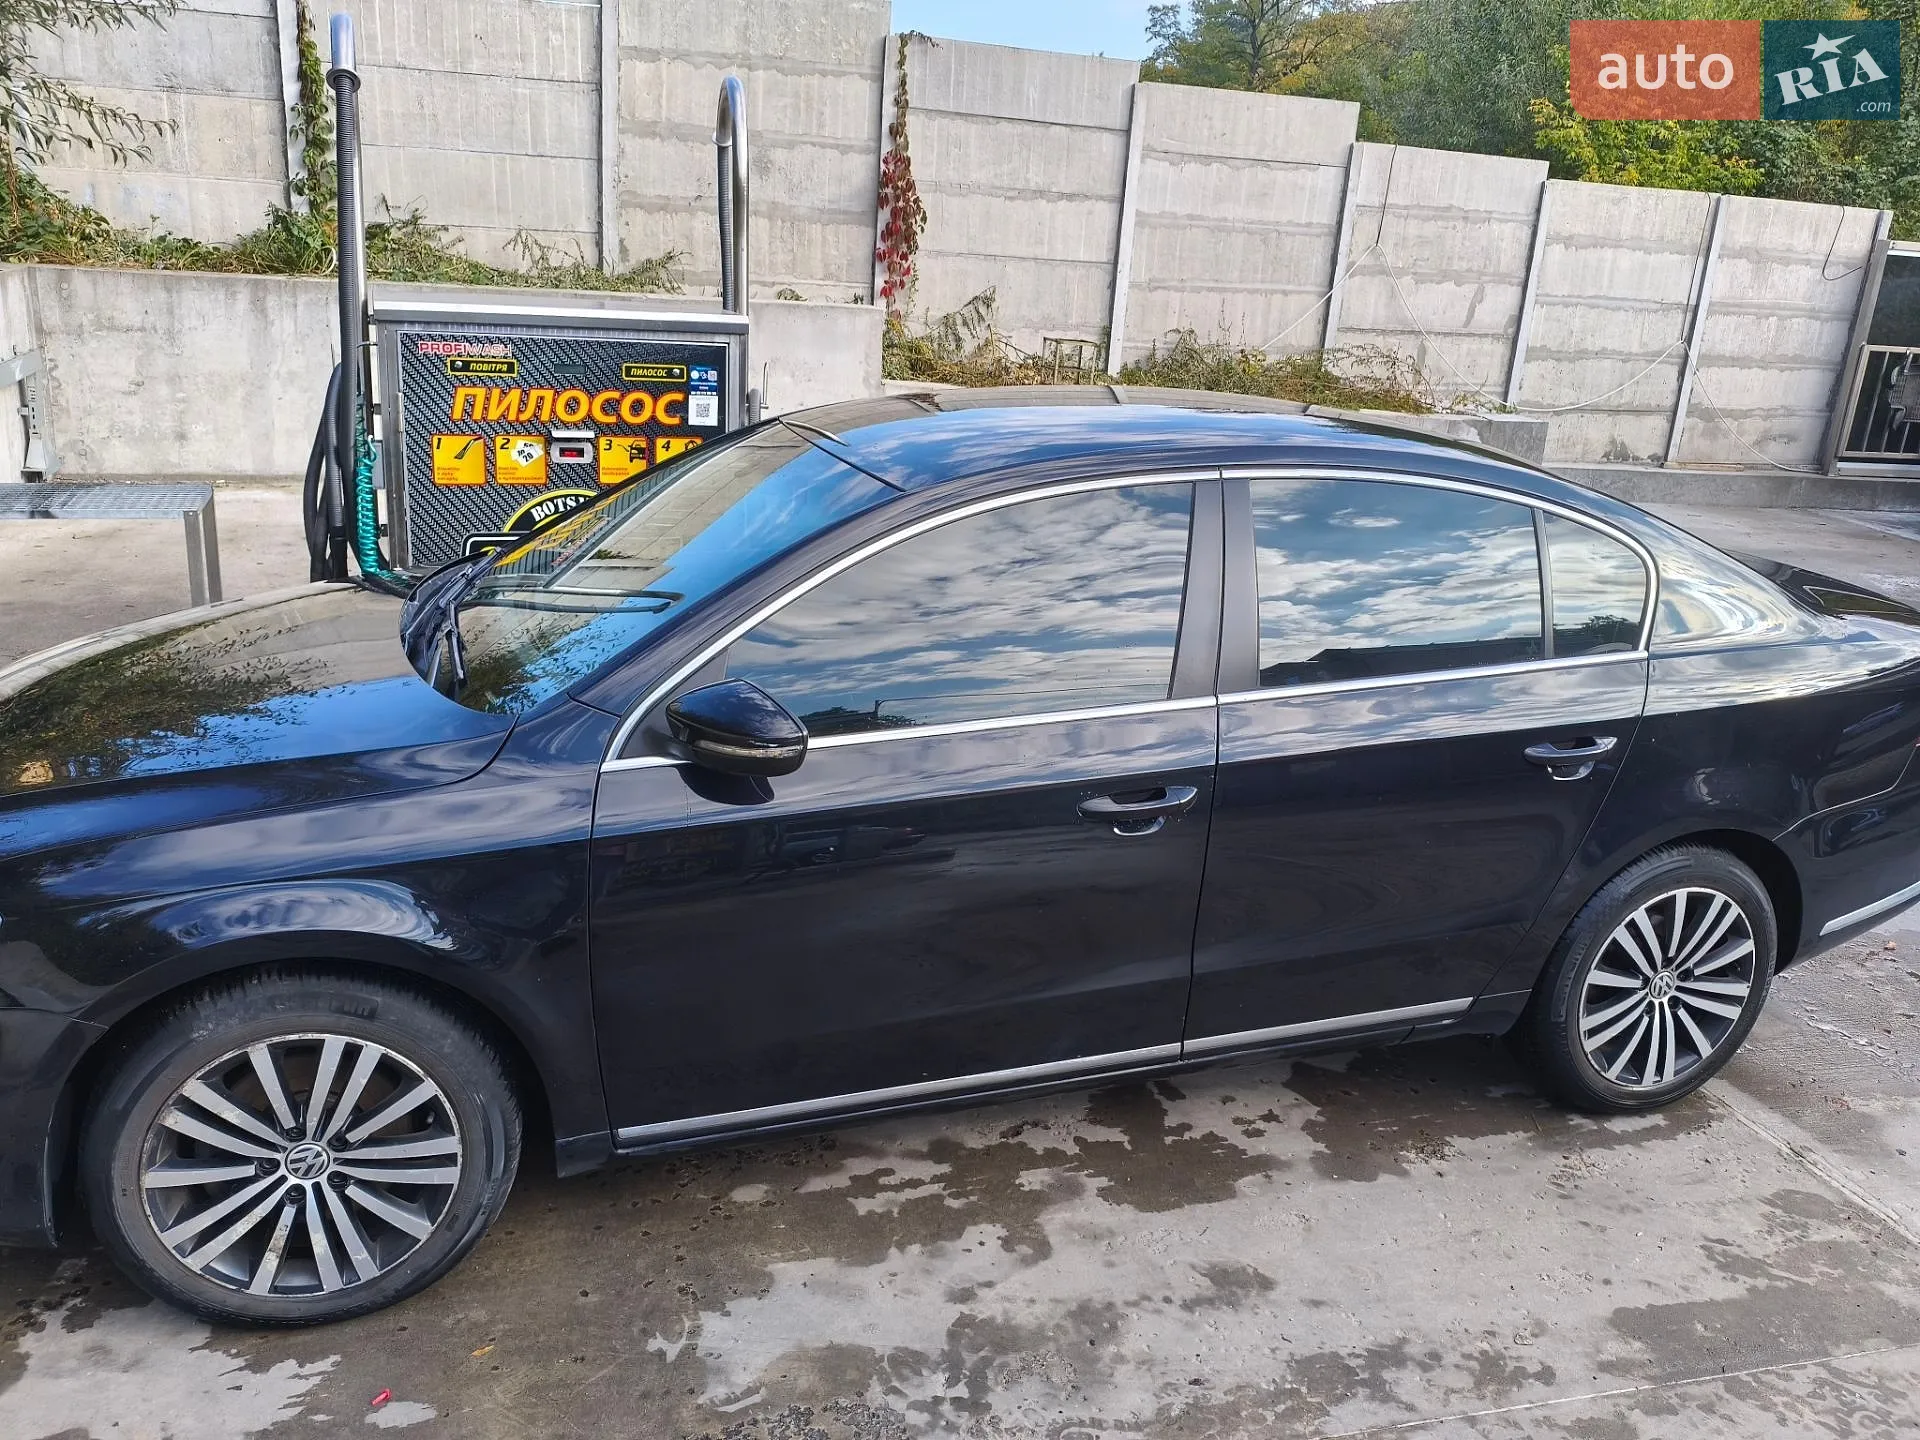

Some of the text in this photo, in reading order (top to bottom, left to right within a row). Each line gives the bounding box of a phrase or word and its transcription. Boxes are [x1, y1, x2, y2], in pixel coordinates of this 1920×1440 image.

[418, 341, 512, 356] PROFIWASH
[469, 362, 508, 372] ПОВІТРЯ
[630, 367, 668, 377] ПИЛОСОС
[451, 386, 686, 426] ПИЛОСОС
[436, 437, 442, 450] 1
[499, 437, 511, 450] 2
[603, 439, 613, 451] 3
[661, 440, 671, 452] 4
[522, 452, 534, 463] 20
